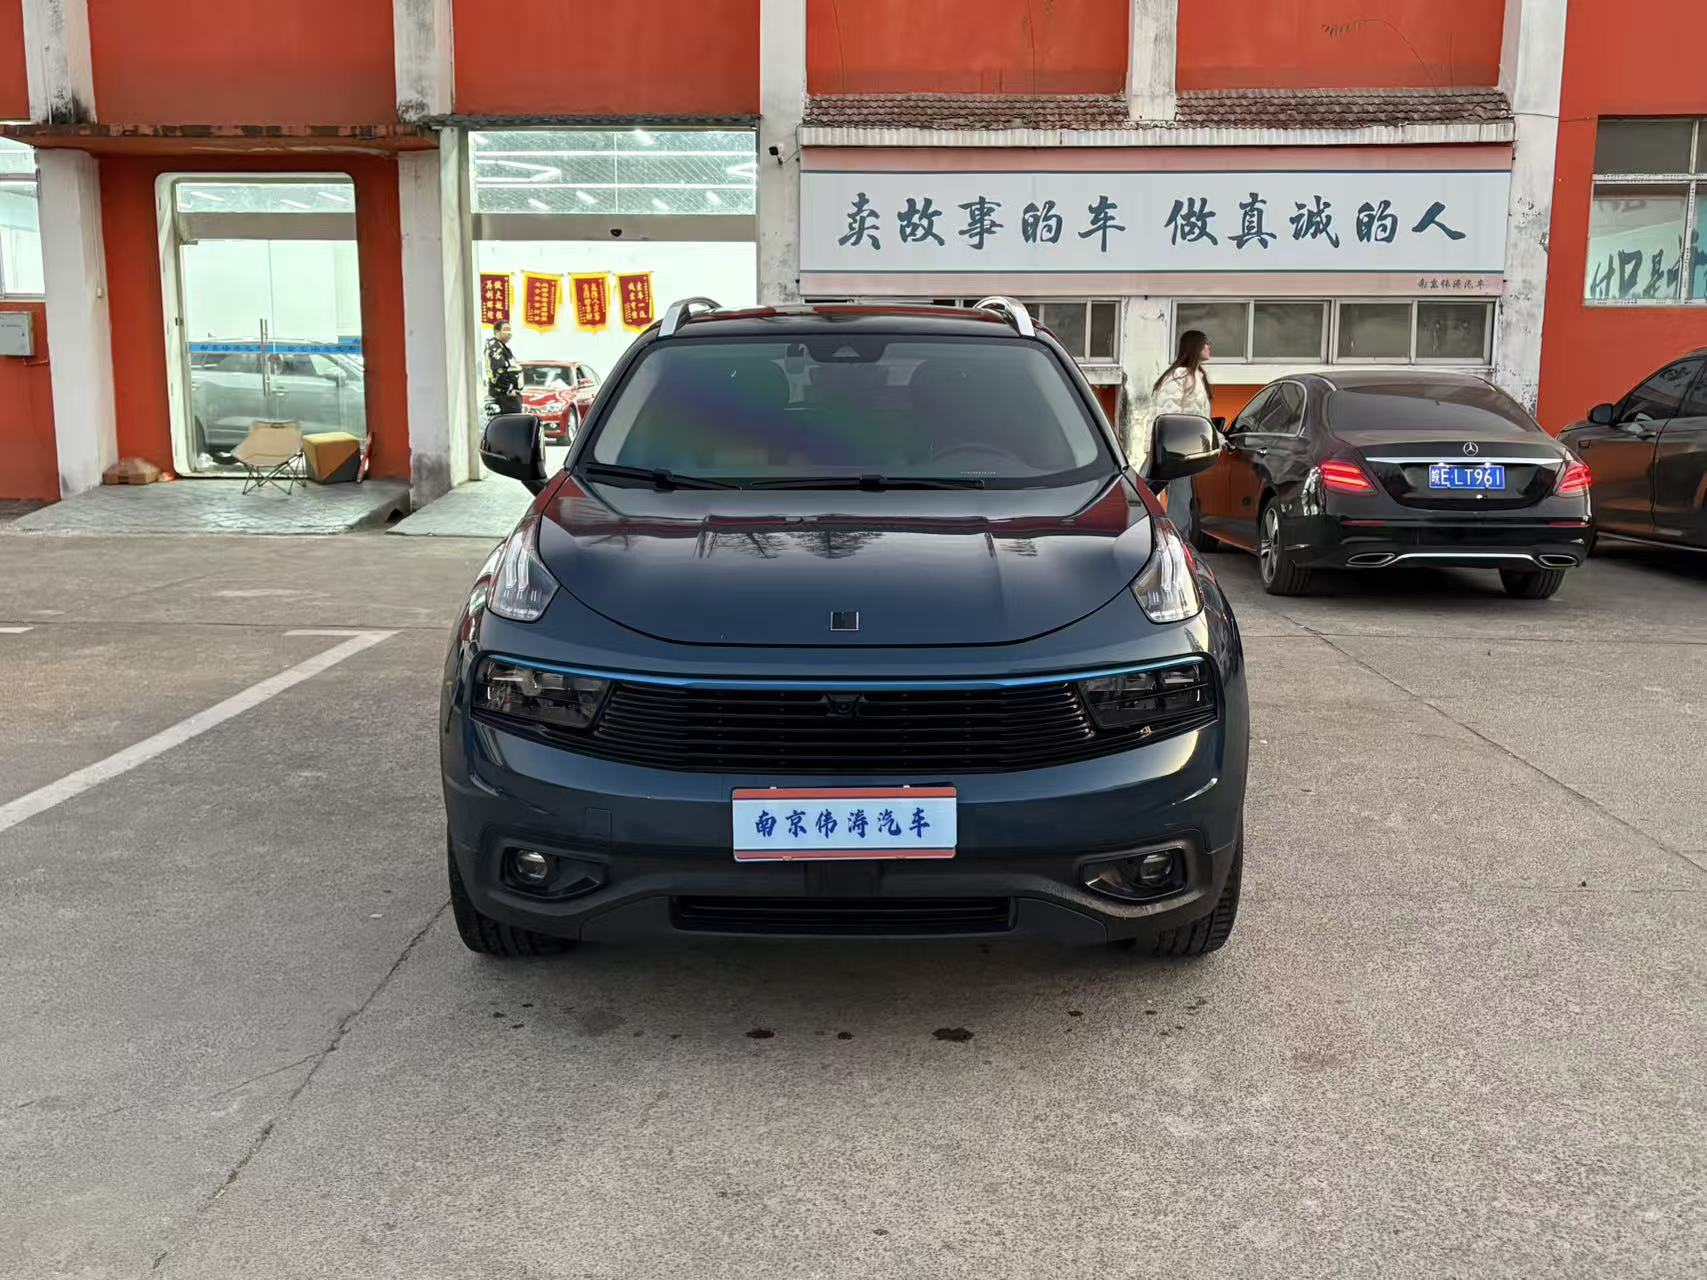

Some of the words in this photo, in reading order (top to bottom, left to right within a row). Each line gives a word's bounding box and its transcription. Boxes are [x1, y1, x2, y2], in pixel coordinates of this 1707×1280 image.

[838, 192, 1127, 253] 卖故事的车
[1164, 192, 1466, 250] 做真诚的人
[755, 807, 931, 839] 南京伟涛汽车
